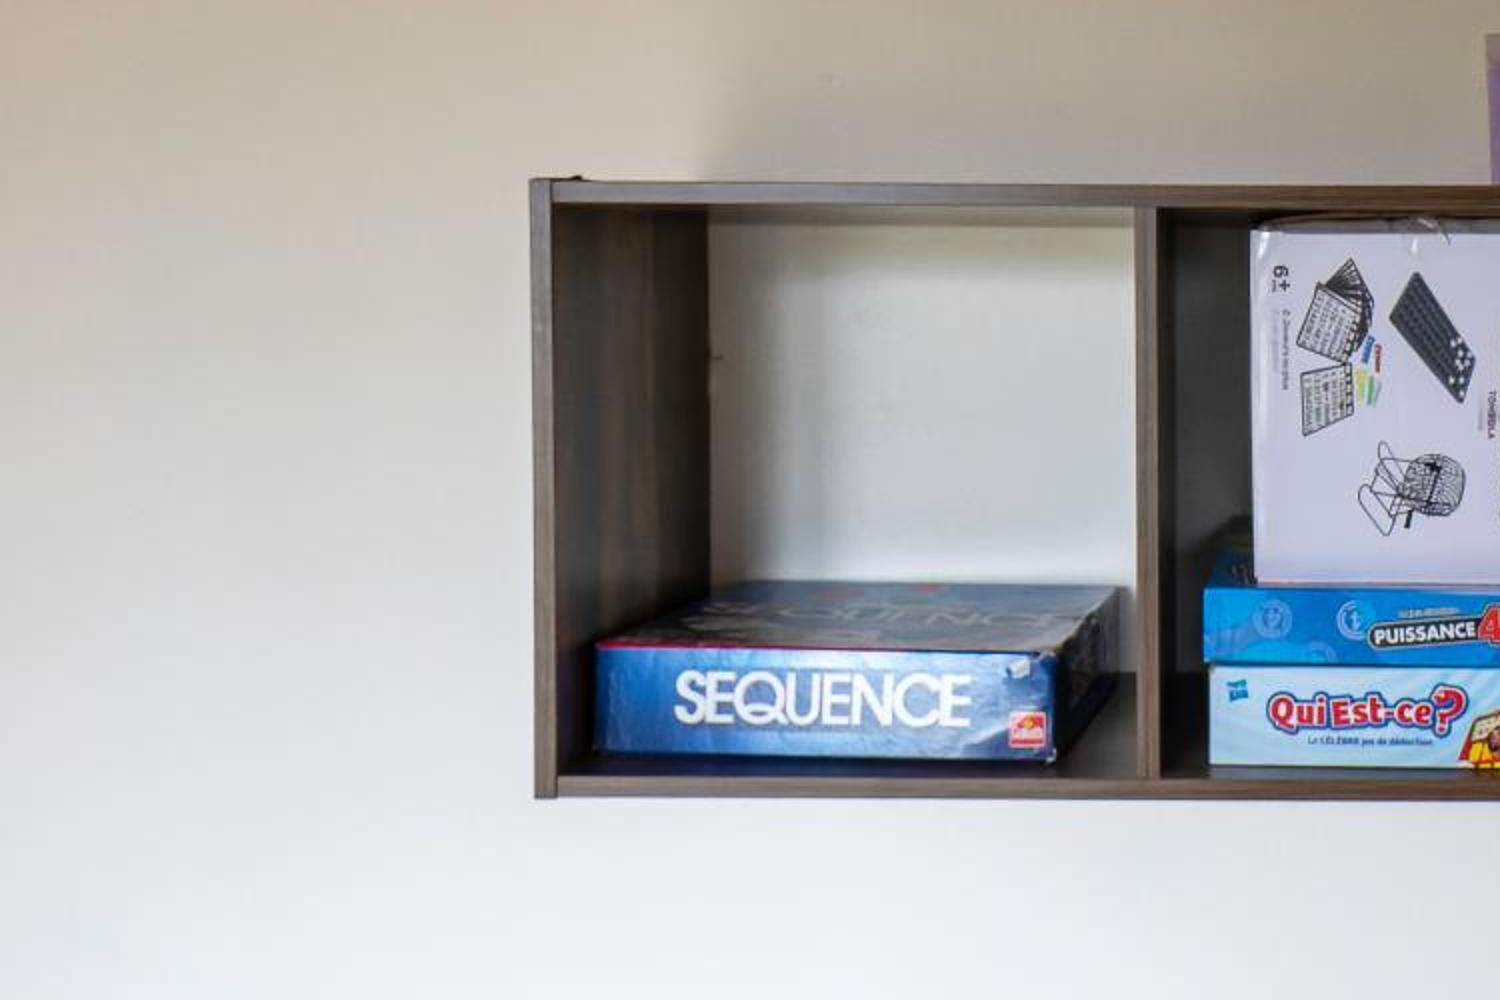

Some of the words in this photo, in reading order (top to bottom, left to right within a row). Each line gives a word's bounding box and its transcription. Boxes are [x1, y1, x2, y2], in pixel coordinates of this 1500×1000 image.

[1374, 621, 1476, 645] PUISSANCE
[674, 669, 975, 729] SEQUENCE
[1270, 694, 1327, 729] Qui
